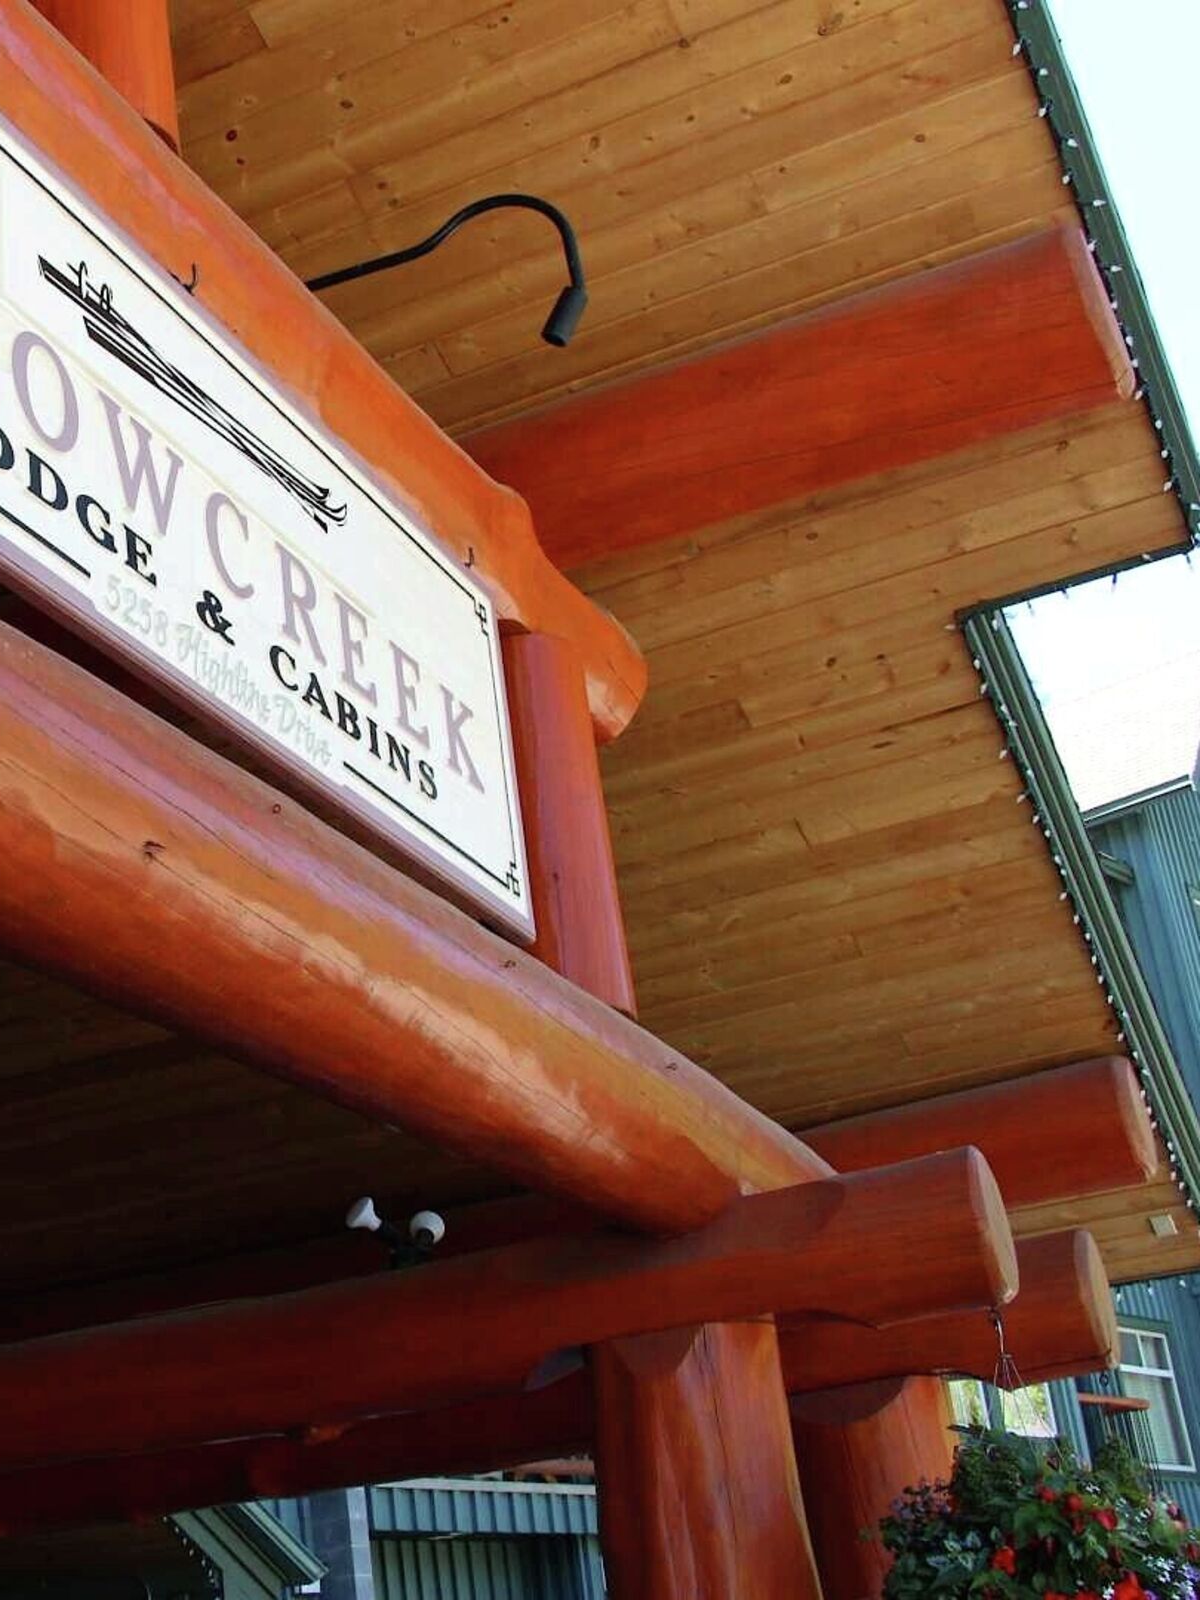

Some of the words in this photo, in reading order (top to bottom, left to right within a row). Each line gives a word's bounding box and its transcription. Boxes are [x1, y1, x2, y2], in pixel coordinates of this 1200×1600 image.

[106, 574, 168, 647] 5258
[175, 622, 270, 723] Highline
[274, 692, 333, 765] Drive
[196, 590, 235, 646] &
[270, 645, 438, 799] CABINS
